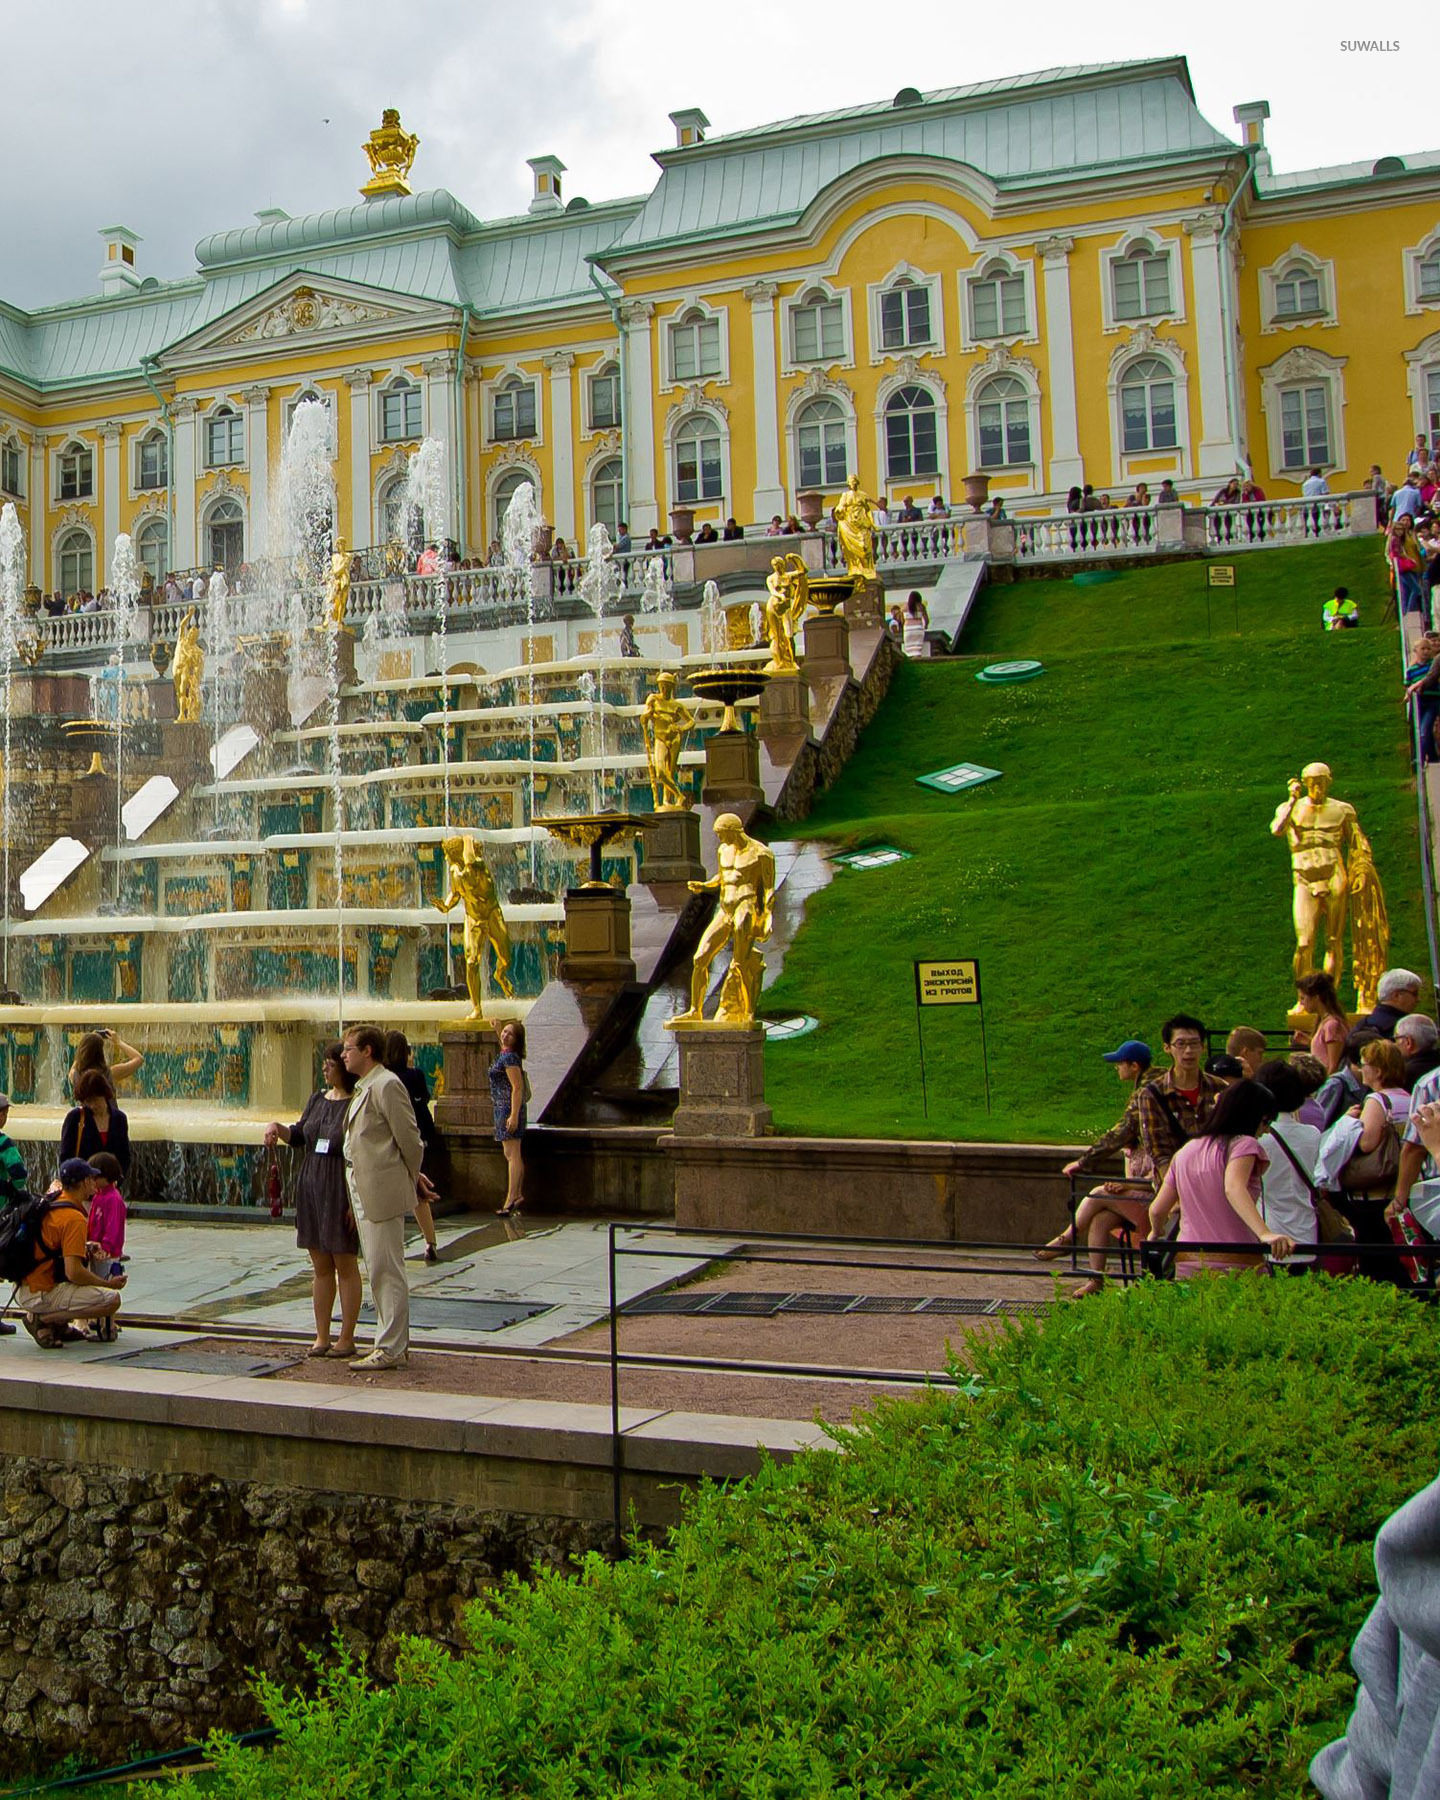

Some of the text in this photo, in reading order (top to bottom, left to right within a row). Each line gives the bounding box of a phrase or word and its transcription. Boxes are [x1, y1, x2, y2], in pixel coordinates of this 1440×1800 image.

[930, 968, 964, 977] ВЫХОД
[925, 987, 973, 996] ИЗ ГРОТОВ
